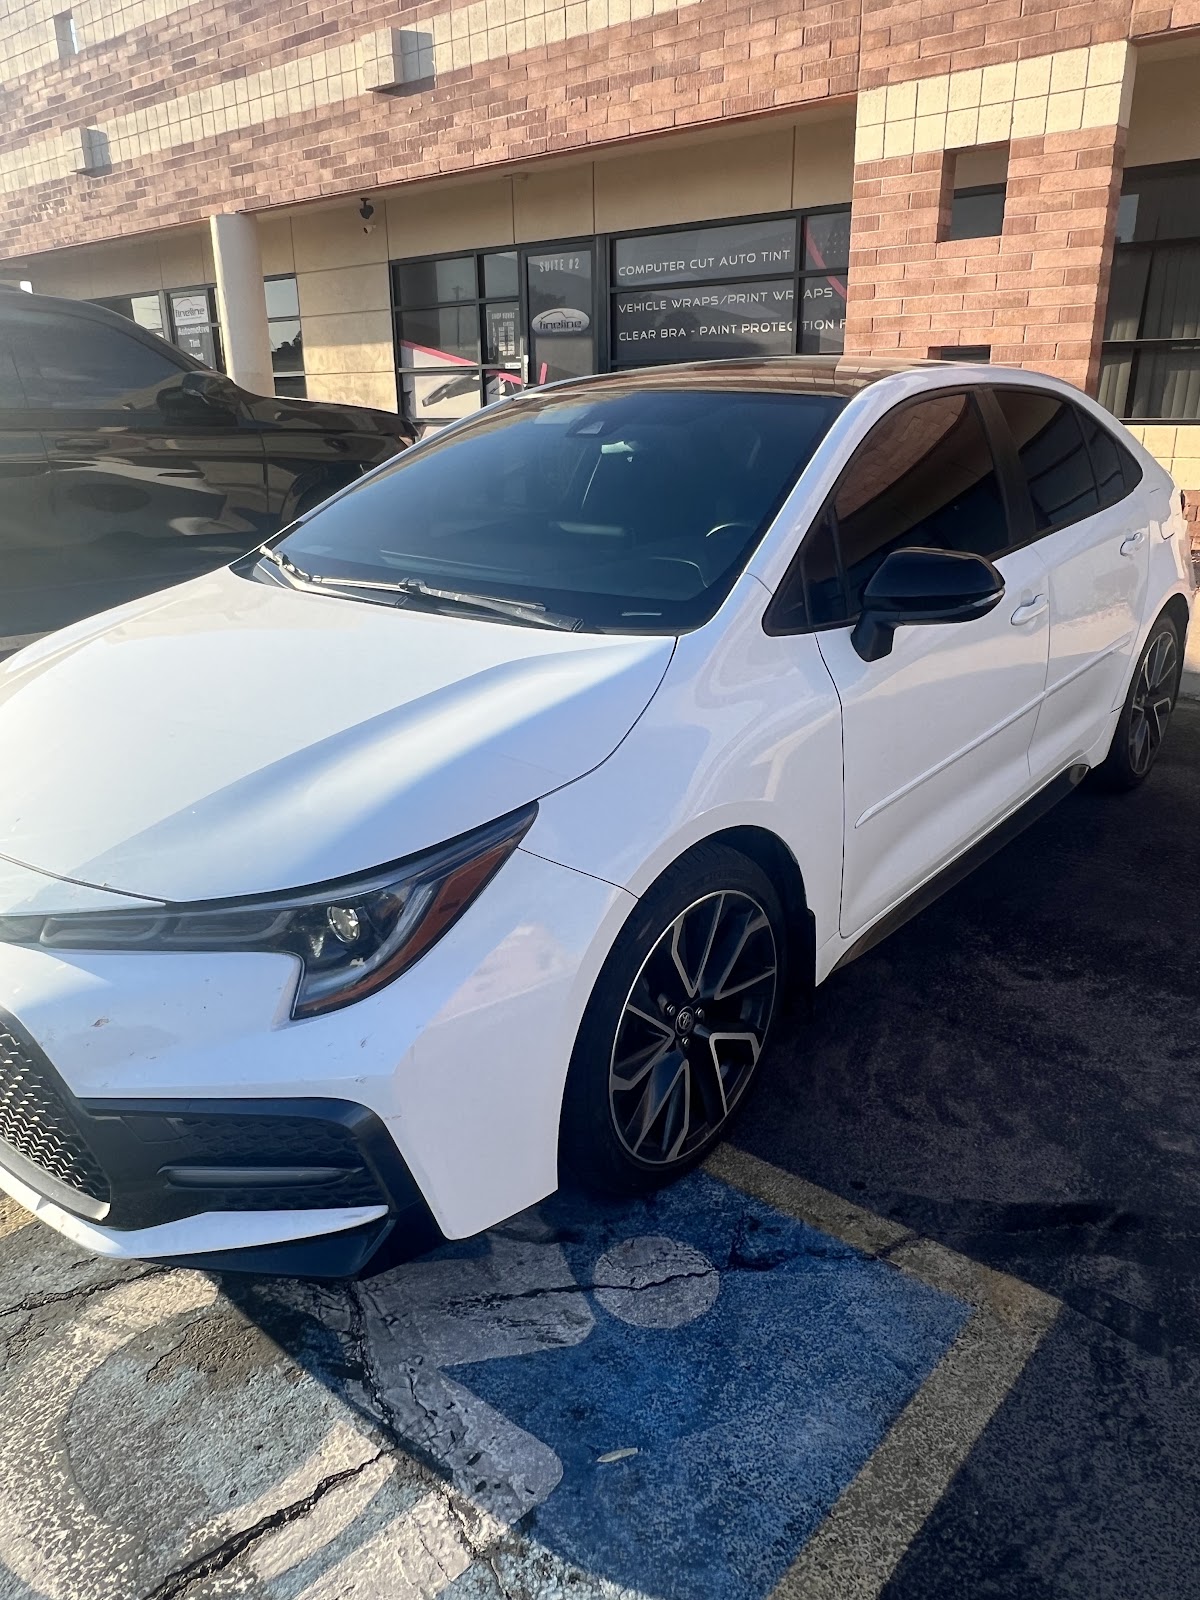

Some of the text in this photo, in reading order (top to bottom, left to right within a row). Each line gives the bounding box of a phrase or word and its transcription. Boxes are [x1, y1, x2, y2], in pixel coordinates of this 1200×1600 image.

[540, 259, 563, 272] SUITE
[618, 249, 791, 277] COMPUTER CUT AUTO TINT
[618, 300, 667, 313] VEHICLE
[671, 291, 768, 309] WRAPS/PRINT
[618, 329, 656, 341] CLEAR
[660, 328, 686, 339] BRA
[699, 324, 737, 335] PAINT
